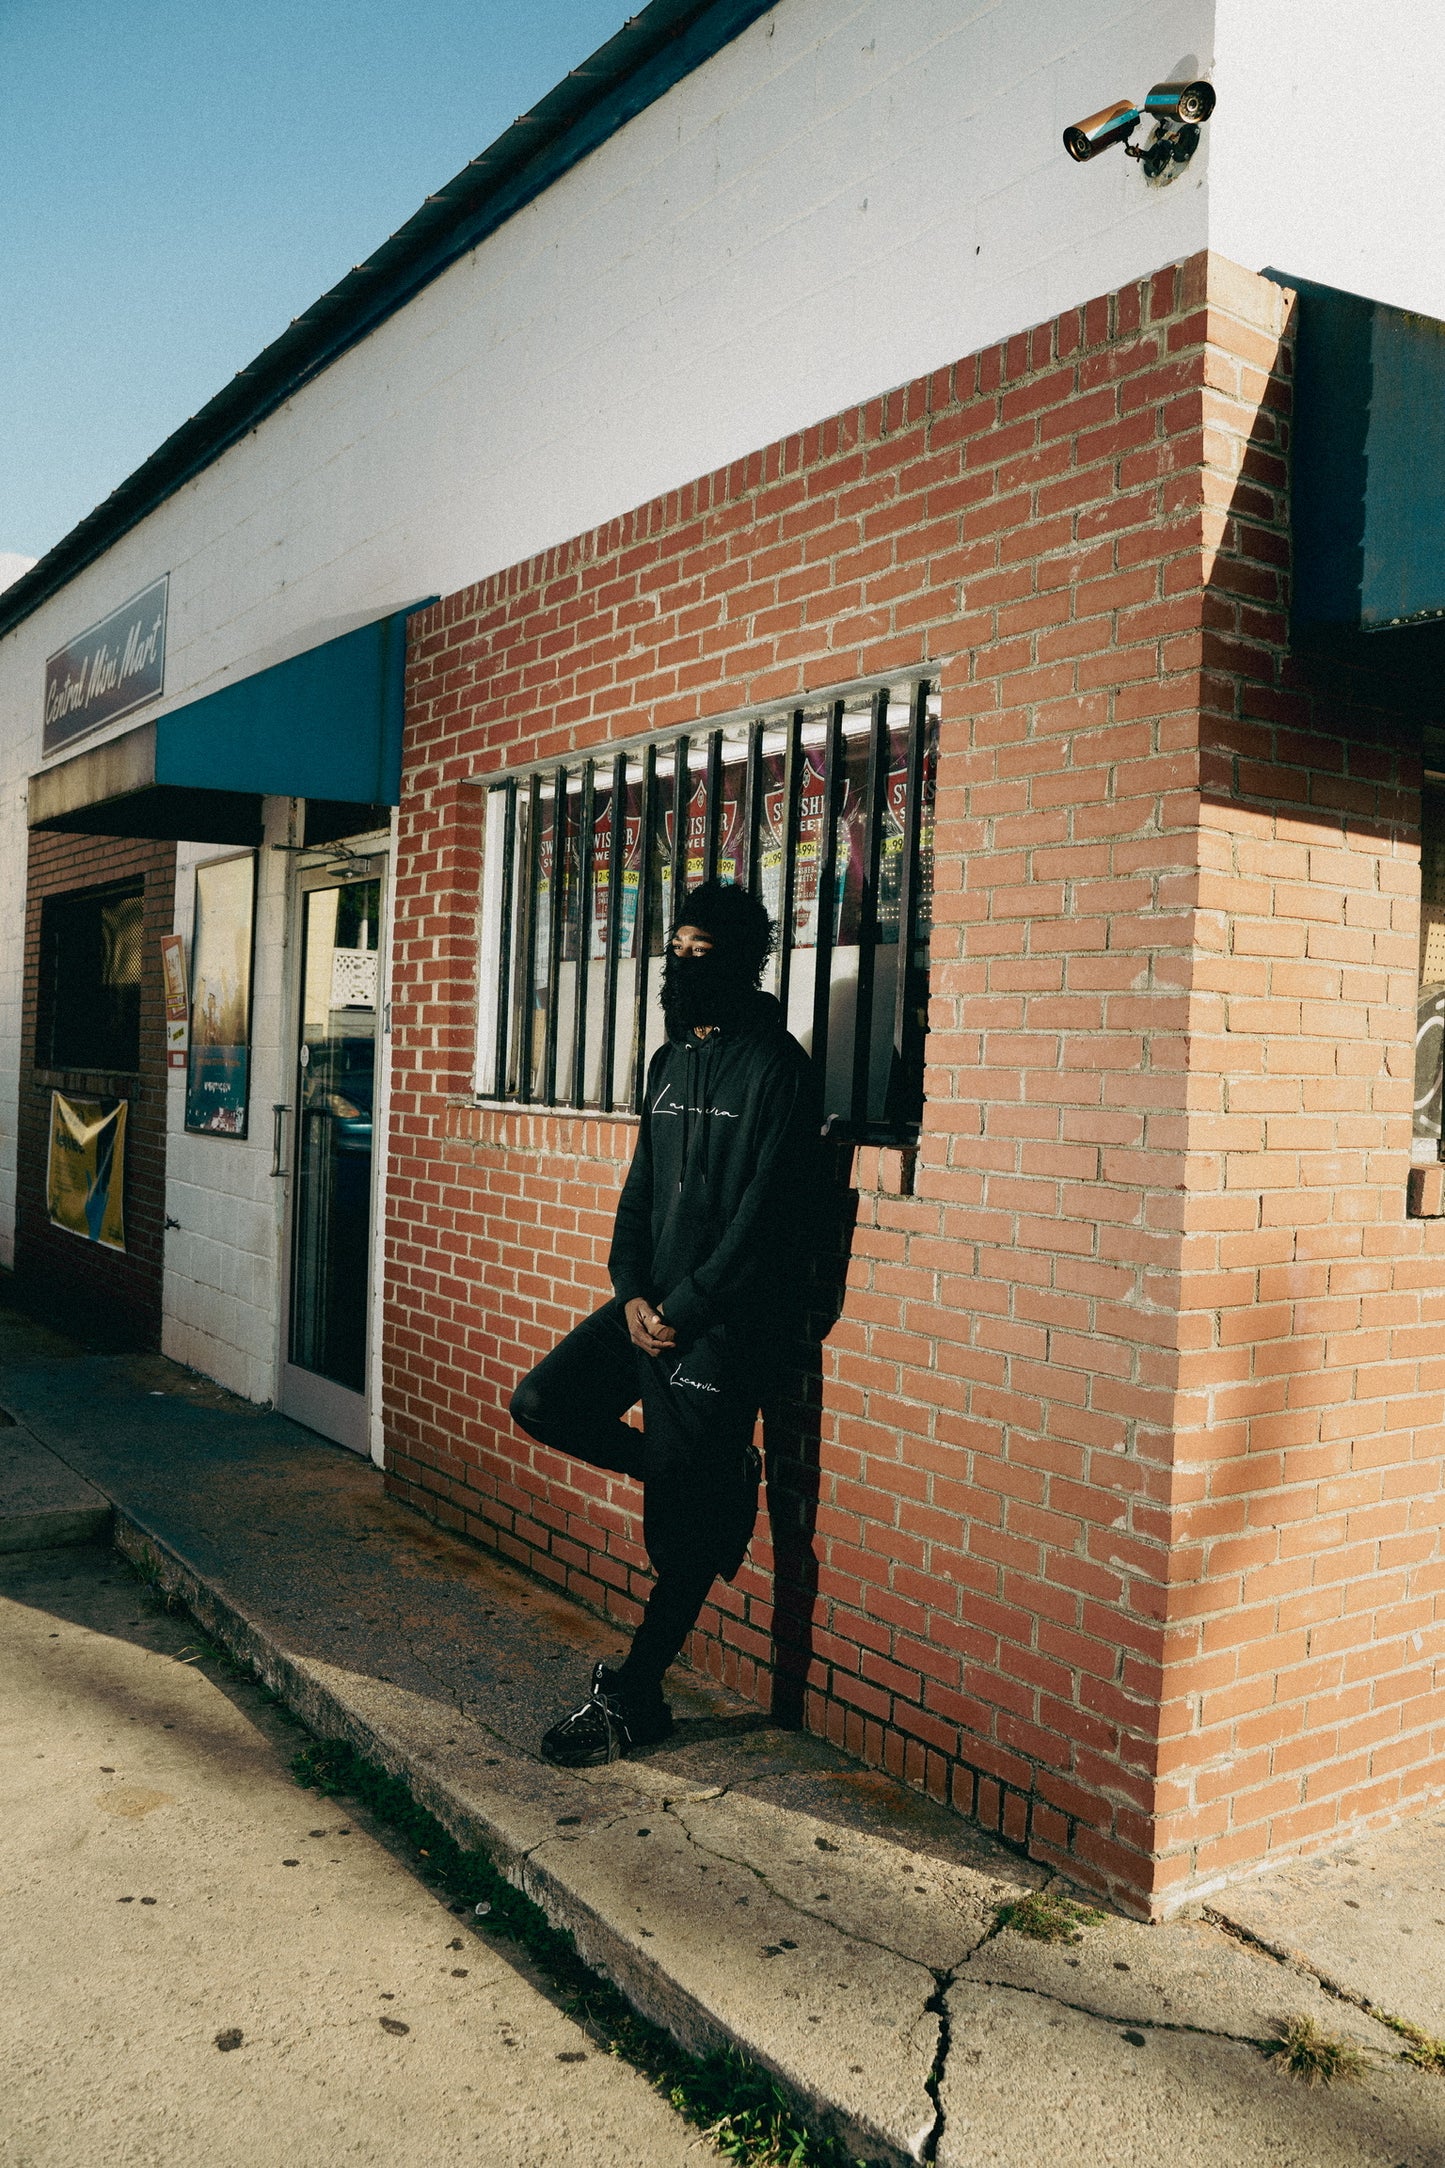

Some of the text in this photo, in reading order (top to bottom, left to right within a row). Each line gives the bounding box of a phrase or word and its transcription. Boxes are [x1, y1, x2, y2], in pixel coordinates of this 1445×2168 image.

[46, 613, 162, 725] Central Mini Mart
